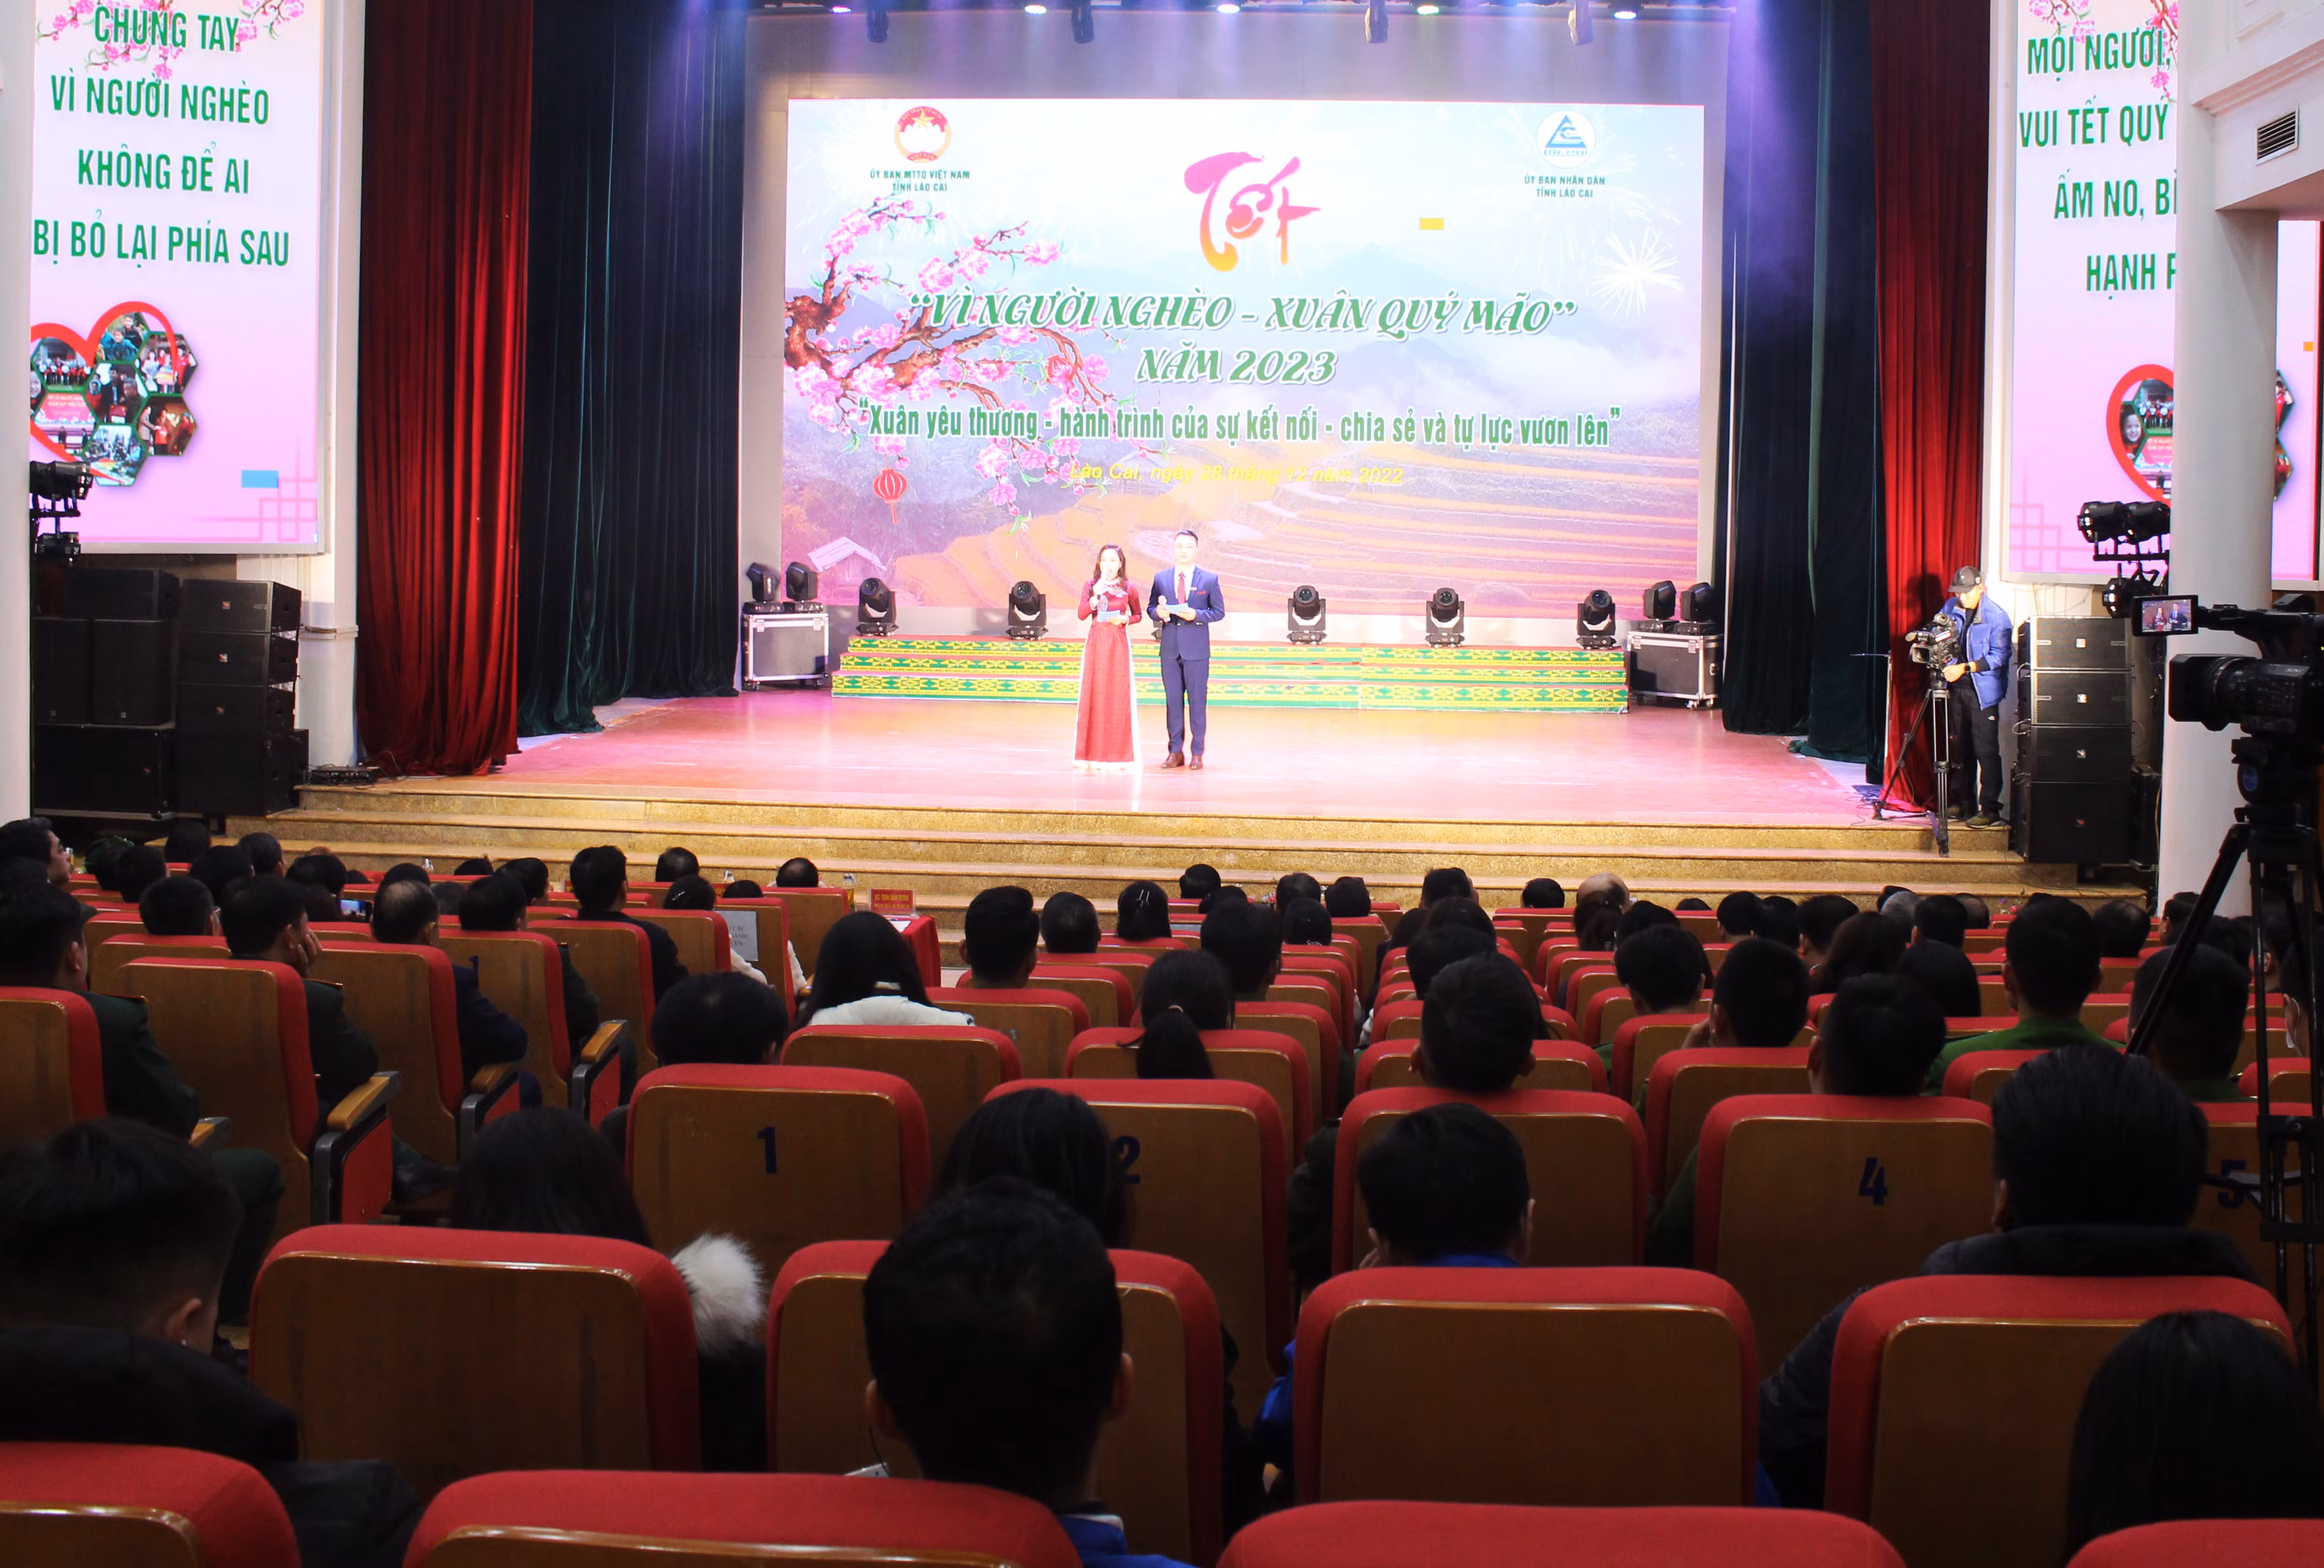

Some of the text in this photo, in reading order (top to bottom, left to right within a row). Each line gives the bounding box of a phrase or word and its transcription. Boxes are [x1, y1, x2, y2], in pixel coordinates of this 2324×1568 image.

[95, 6, 239, 51] CHUNG TAY
[2028, 36, 2074, 82] MỌI
[51, 68, 269, 125] VÌ NGƯỜI NGHÈO
[2019, 95, 2169, 147] VUI TẾT QUÝ
[78, 141, 249, 194] KHÔNG ĐỂ AI
[884, 171, 901, 179] BAN
[905, 171, 926, 179] MTTQ
[930, 169, 947, 180] VIỆT
[950, 171, 970, 179] NAM
[934, 183, 947, 191] CAI
[1538, 176, 1556, 184] BAN
[1579, 189, 1593, 198] CAI
[2054, 168, 2093, 219] ẤM
[2104, 179, 2144, 221] NO,
[34, 209, 289, 268] BỊ BỎ LẠI PHÍA SAU
[2086, 253, 2156, 299] HẠNH
[978, 286, 1099, 326] NGƯỜI
[1103, 288, 1233, 328] NGHÈO
[1265, 289, 1374, 330] XUÂN
[1378, 291, 1461, 340] QUÝ
[1137, 341, 1335, 382] NĂM 2023
[927, 405, 961, 439] yêu
[969, 406, 1037, 440] thương
[1060, 407, 1108, 437] hành
[1117, 407, 1164, 438] trình
[1172, 405, 1208, 439] của
[1216, 411, 1239, 446] sự
[1247, 404, 1278, 441] kết
[1286, 406, 1317, 441] nối
[1341, 412, 1385, 442] chia
[1392, 408, 1415, 443] sẻ
[1423, 411, 1446, 443] và
[1455, 414, 1474, 450] tự
[1481, 413, 1512, 451] lực
[1520, 416, 1568, 445] vươn
[1070, 463, 1103, 479] Lào
[1109, 463, 1143, 481] Cai,
[1150, 464, 1195, 483] ngày
[1228, 466, 1279, 486] tháng
[1287, 467, 1307, 482] 12
[1359, 467, 1404, 484] 2022
[757, 1126, 777, 1174] 1
[1115, 1136, 1141, 1184] 2
[1859, 1157, 1888, 1205] 4
